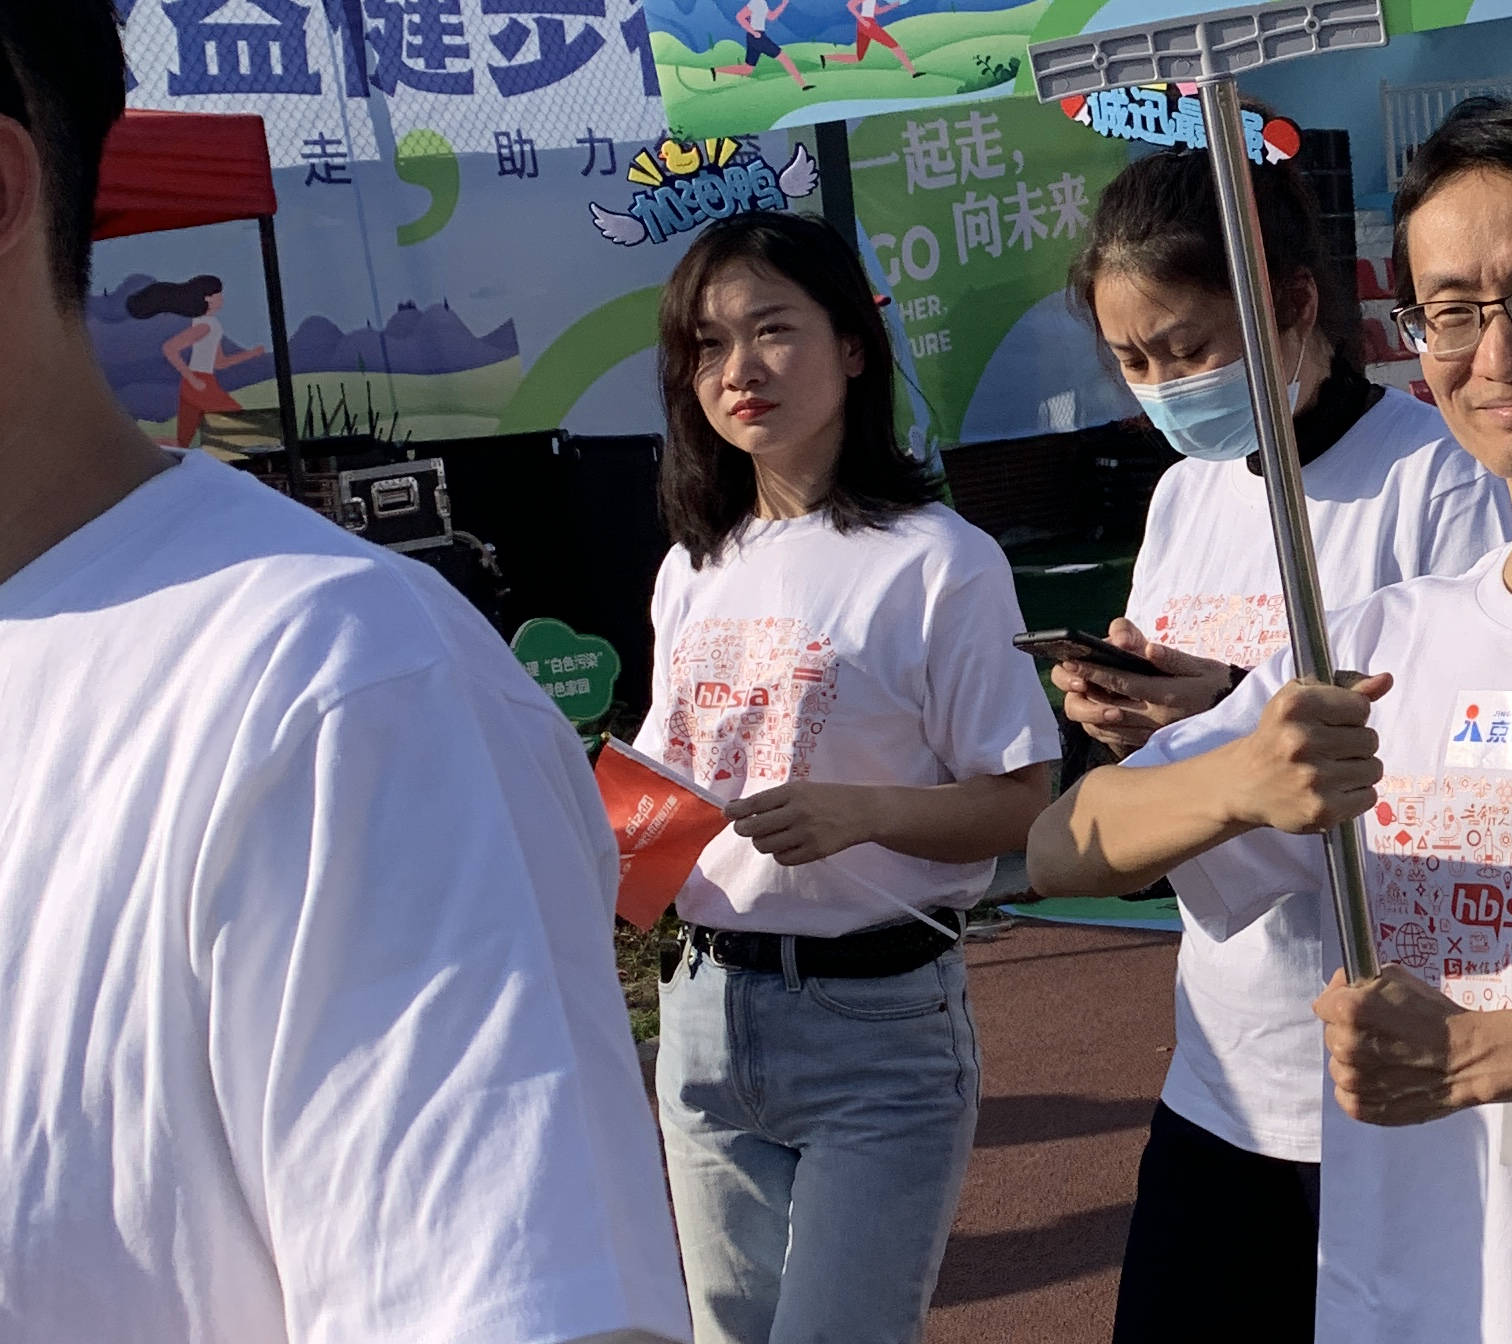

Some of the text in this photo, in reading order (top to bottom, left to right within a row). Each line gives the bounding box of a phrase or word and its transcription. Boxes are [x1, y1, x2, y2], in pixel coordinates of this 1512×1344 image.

[630, 159, 787, 244] 加油鸭
[952, 172, 1091, 265] 向未来
